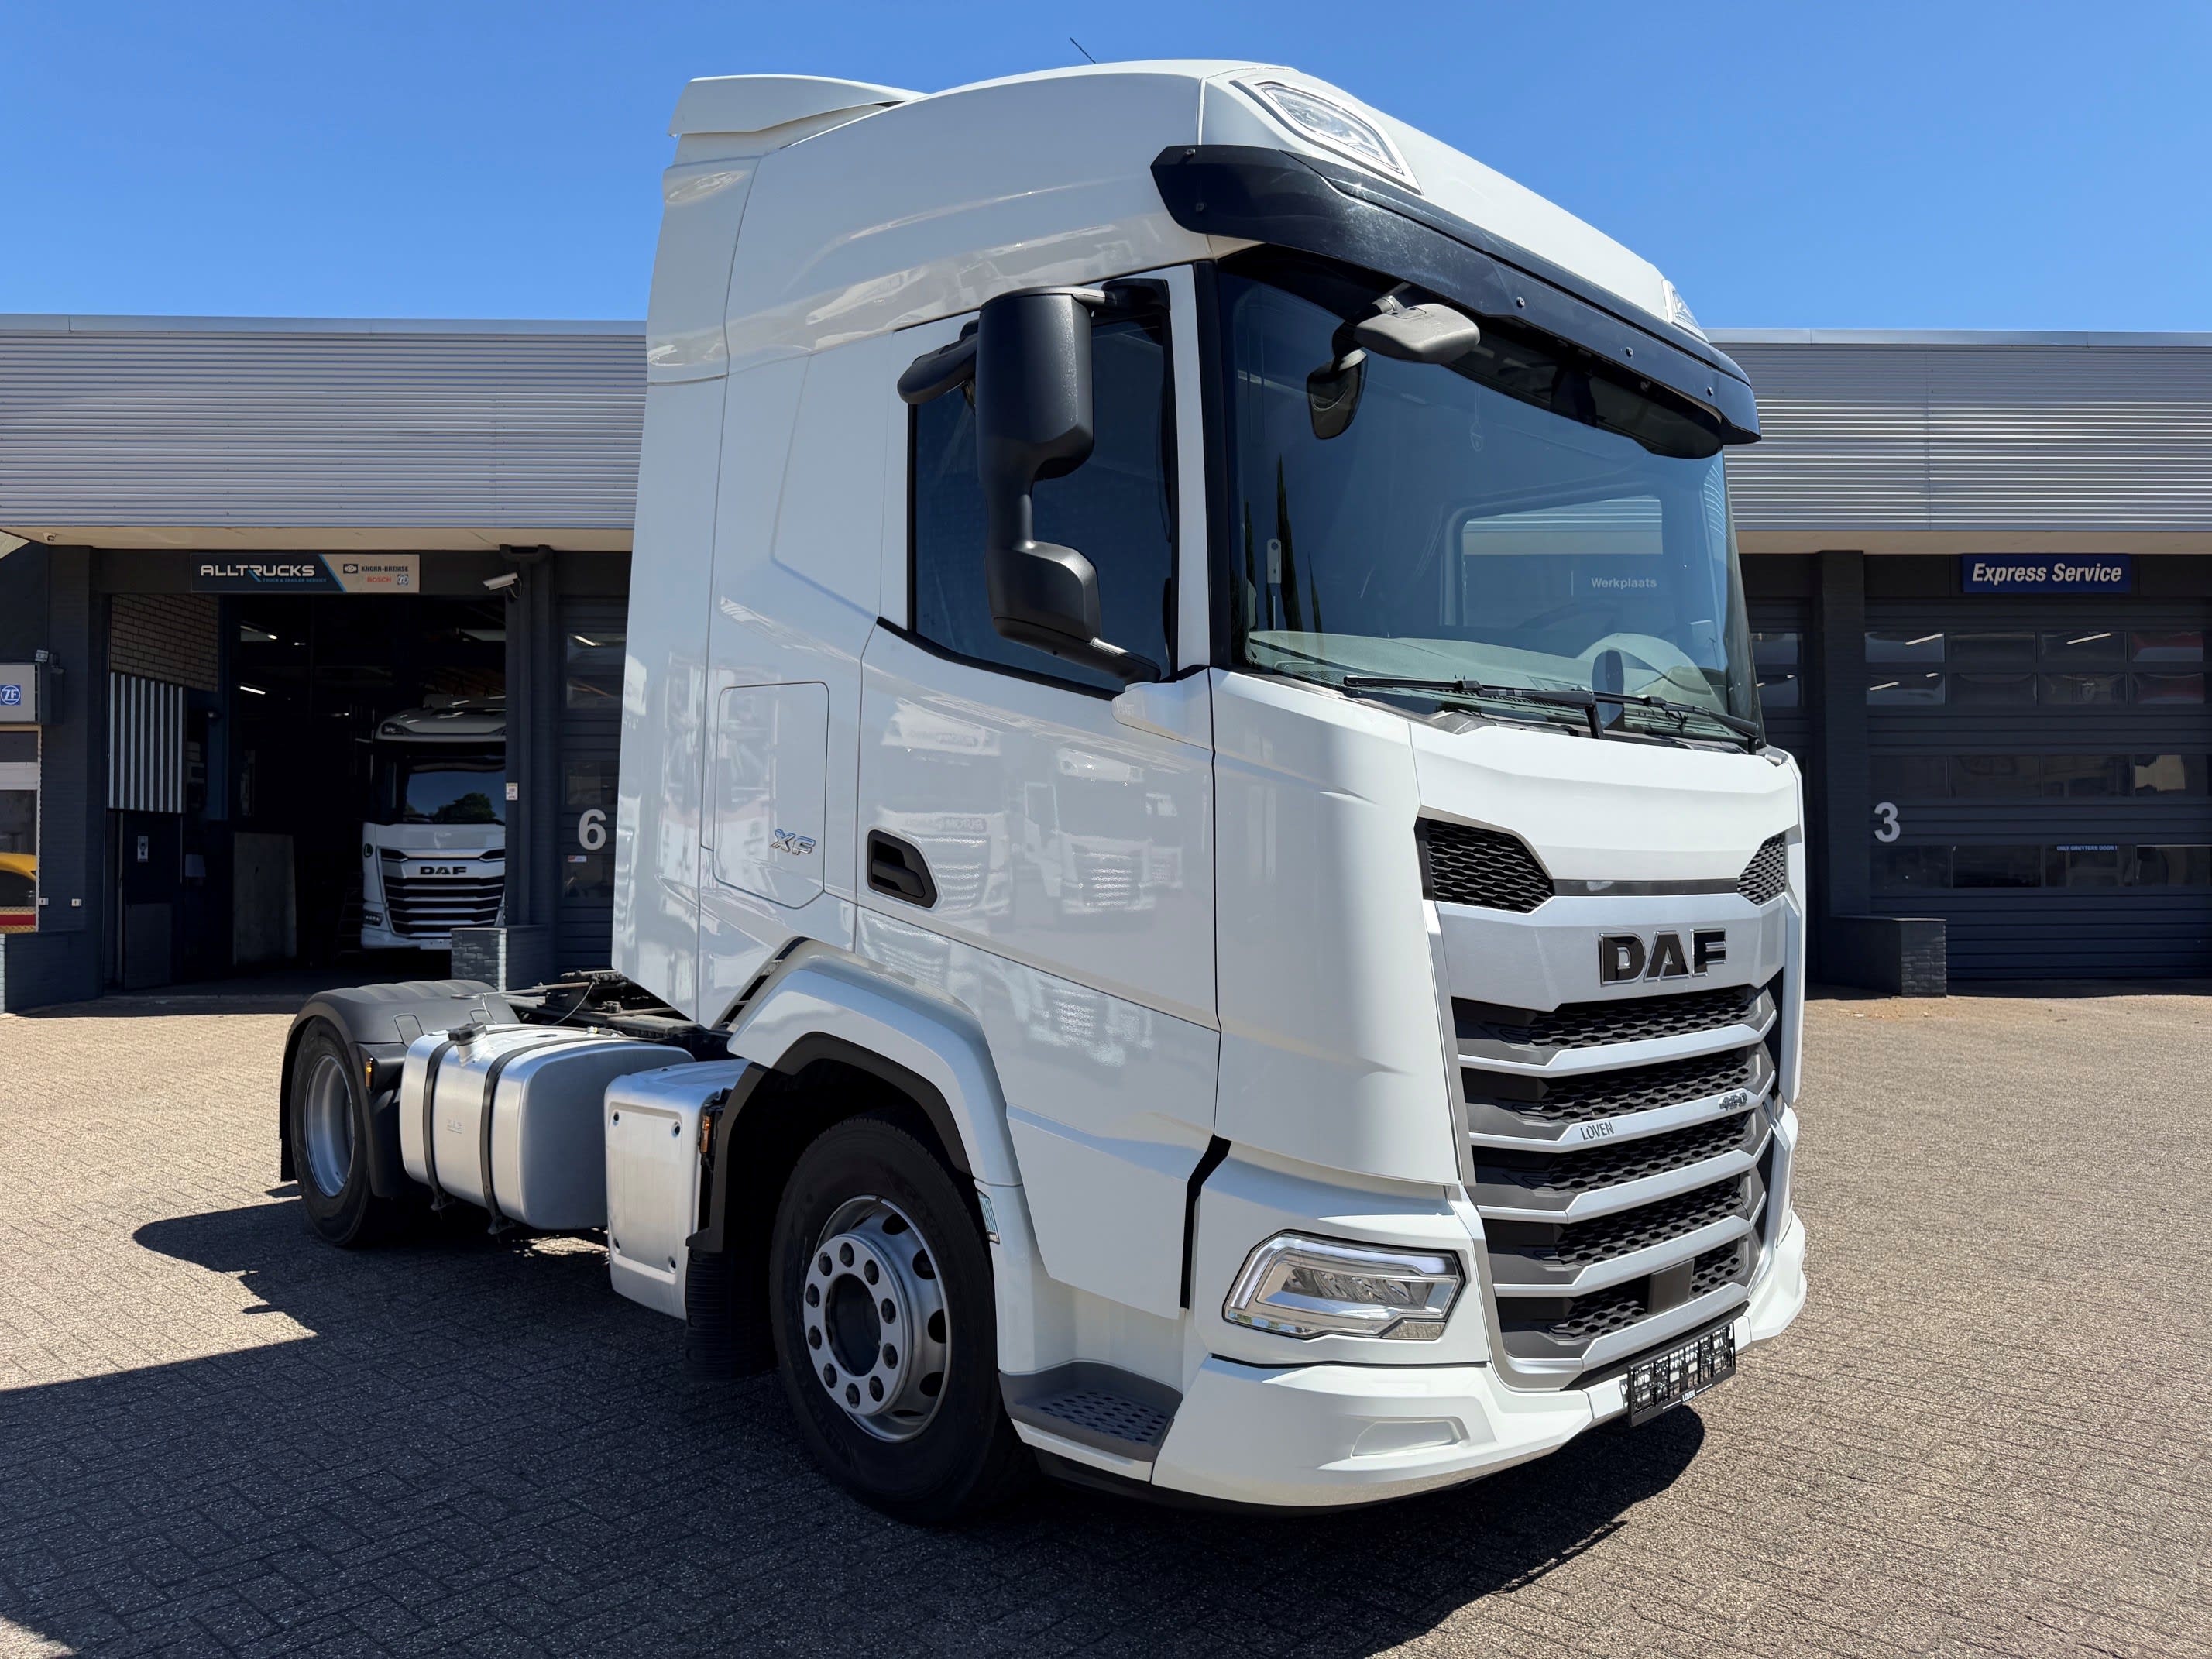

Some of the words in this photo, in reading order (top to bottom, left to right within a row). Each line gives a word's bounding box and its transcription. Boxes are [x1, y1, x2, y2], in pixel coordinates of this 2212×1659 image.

[200, 565, 315, 576] ALLTRUCKS
[1972, 562, 2047, 586] Express
[2052, 562, 2122, 582] Service
[1591, 577, 1657, 589] Werkplaats
[2, 688, 19, 702] ZF
[579, 809, 606, 850] 6
[1874, 802, 1901, 843] 3
[768, 829, 816, 855] XF
[1598, 929, 1726, 988] DAF
[1580, 1121, 1615, 1141] LOVEN
[1681, 1389, 1696, 1402] LOVEN
